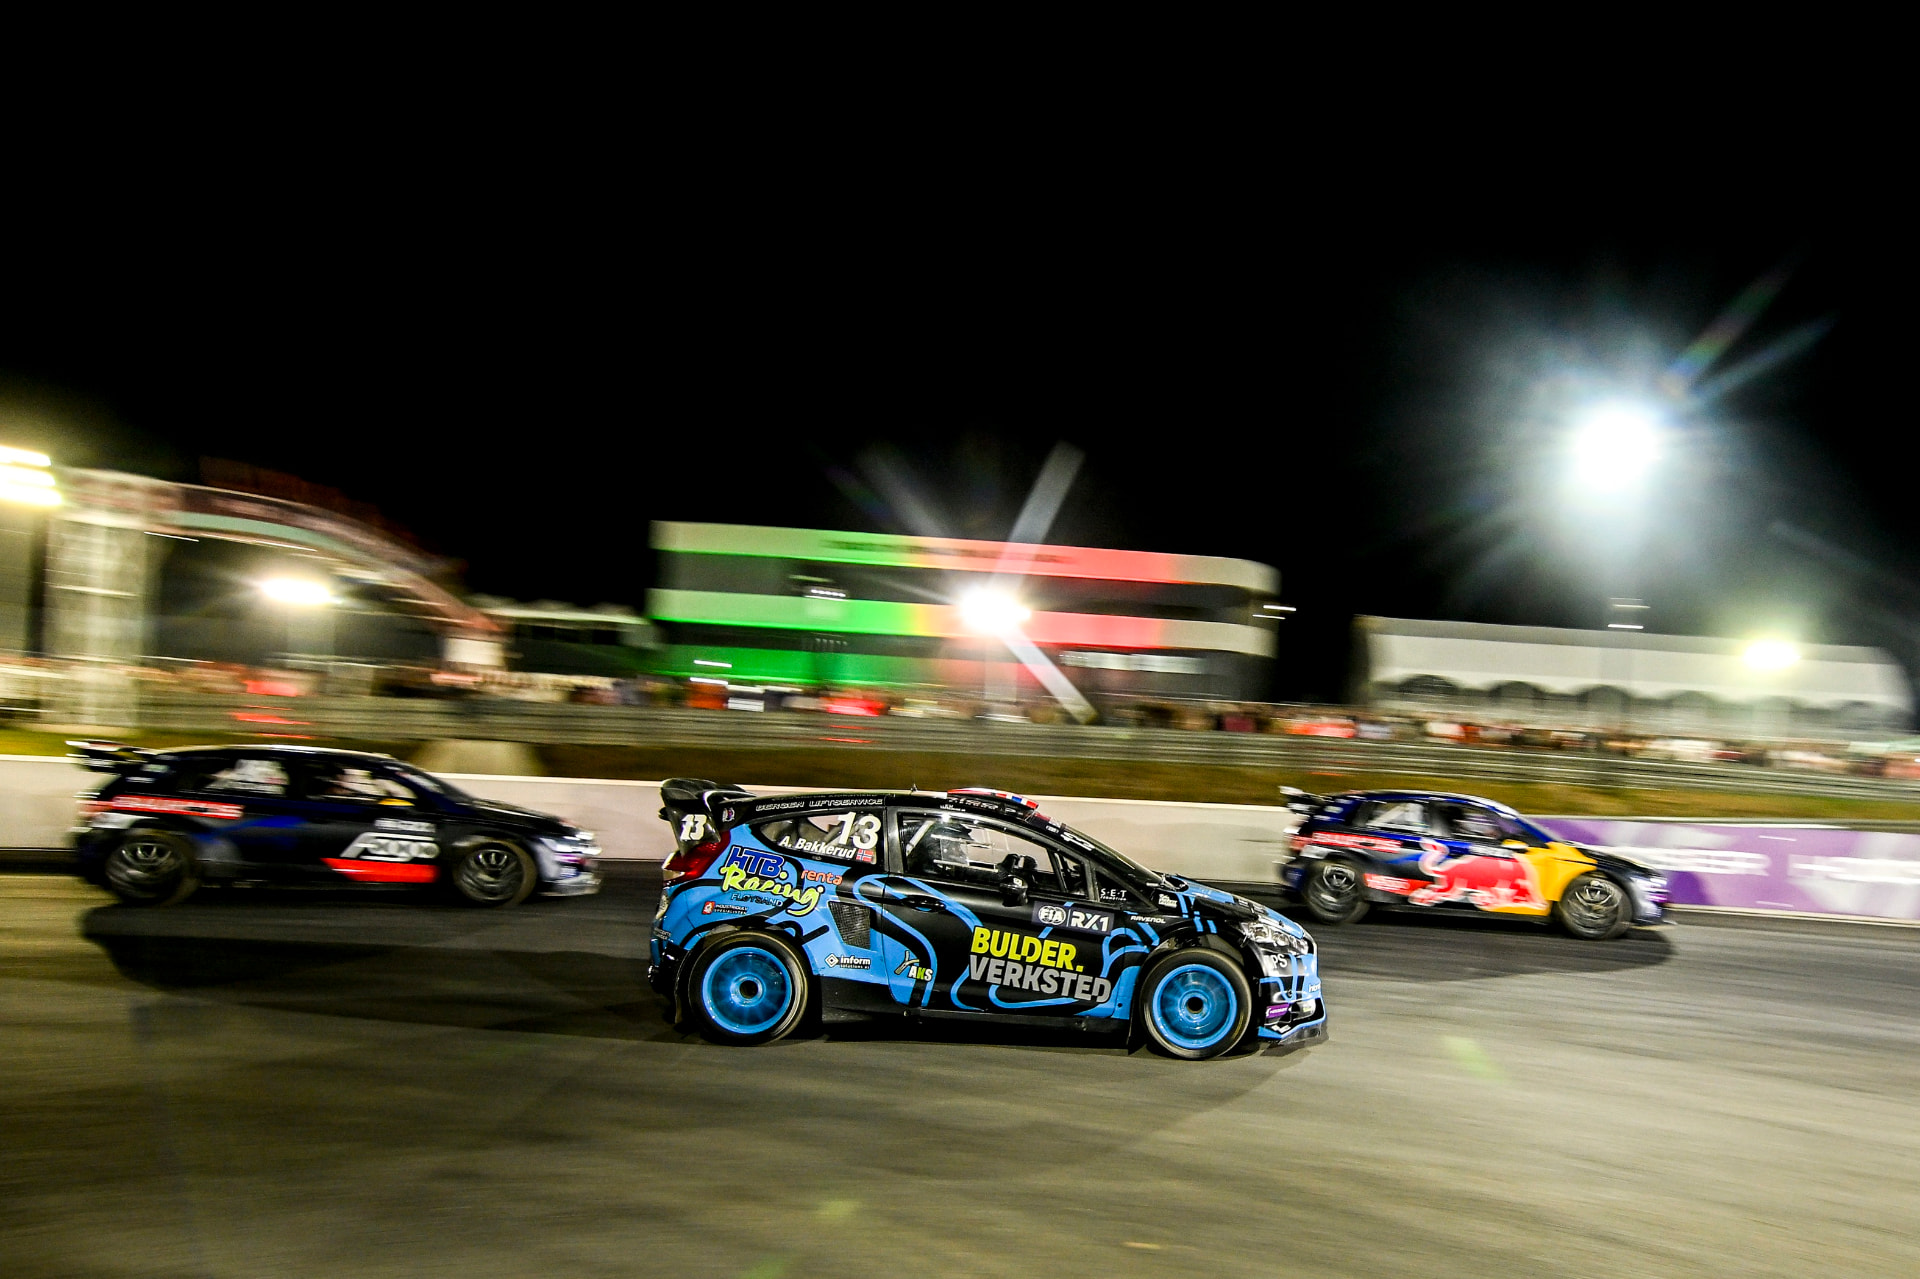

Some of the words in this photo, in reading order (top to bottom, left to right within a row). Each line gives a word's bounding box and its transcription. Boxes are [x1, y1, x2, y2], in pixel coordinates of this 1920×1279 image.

[809, 798, 883, 808] LIFTSERVICE
[680, 814, 707, 840] 13
[838, 811, 882, 850] 13
[778, 835, 792, 848] A.
[795, 838, 856, 859] Bakkerud
[720, 863, 825, 916] Racing
[801, 869, 843, 886] renta
[1070, 910, 1109, 932] RX1
[1130, 915, 1166, 924] RAVENOL
[840, 955, 871, 965] inform
[971, 926, 1084, 972] BULDER.
[969, 954, 1112, 1003] VERKSTED
